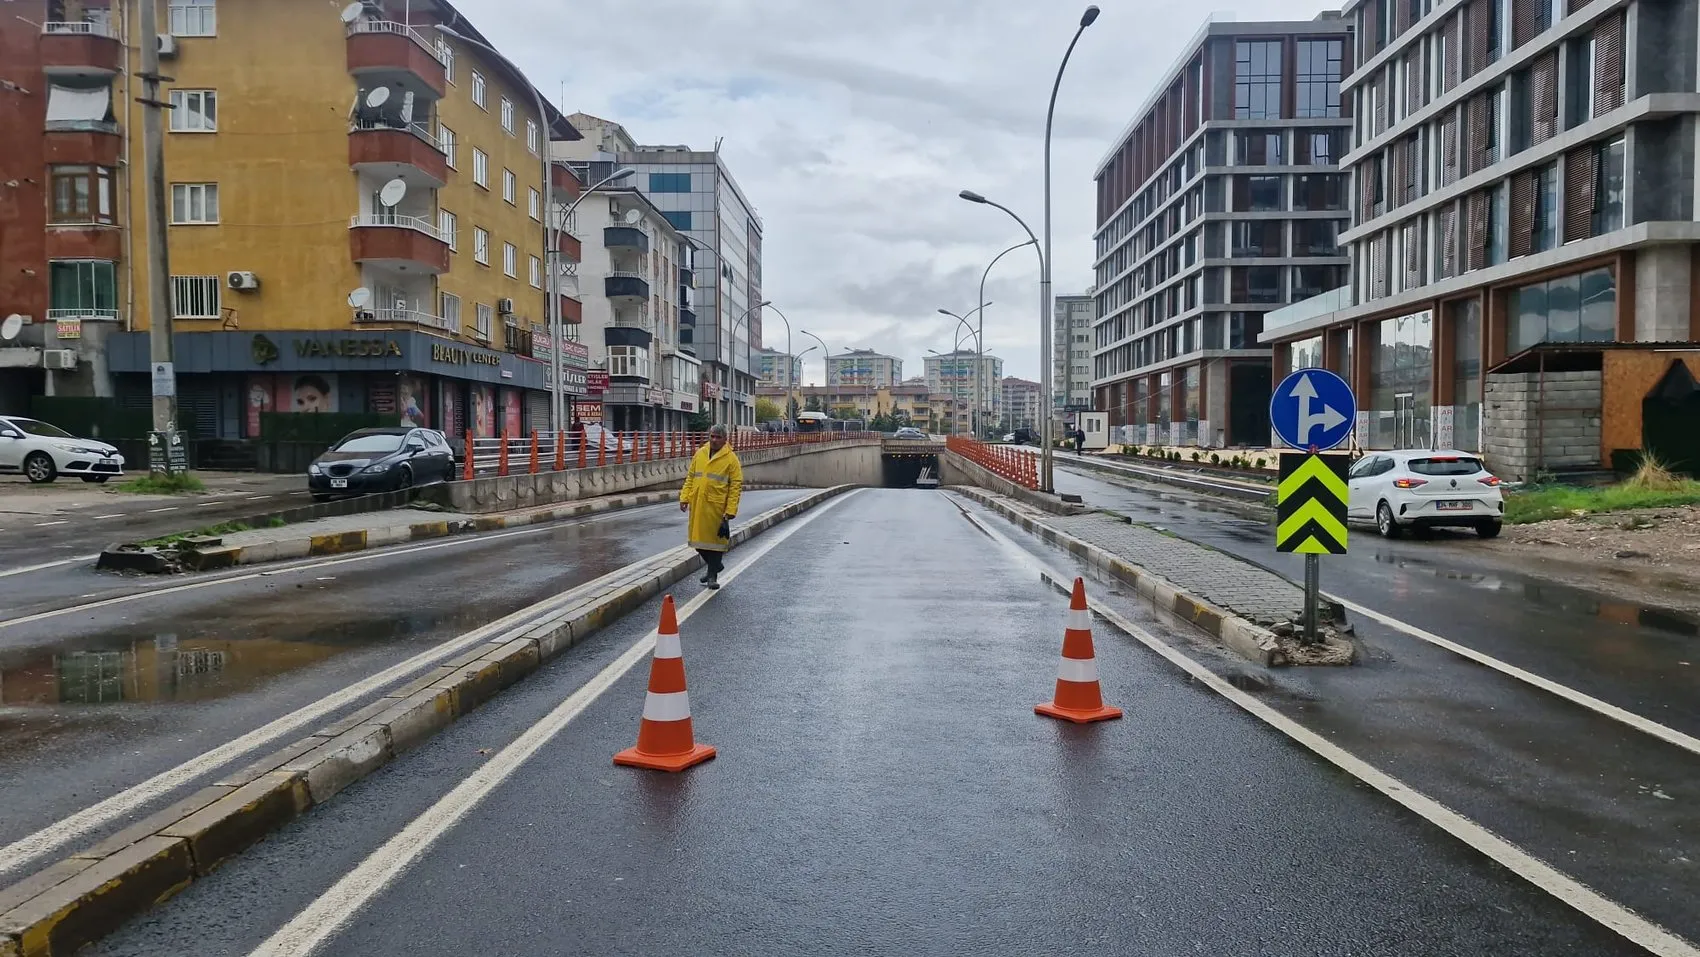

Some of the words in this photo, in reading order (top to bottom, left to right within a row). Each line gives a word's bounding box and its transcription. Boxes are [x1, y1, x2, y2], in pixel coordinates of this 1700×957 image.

[294, 340, 402, 358] VANESSA
[431, 343, 470, 366] BEAUTY
[472, 352, 500, 367] CENTER
